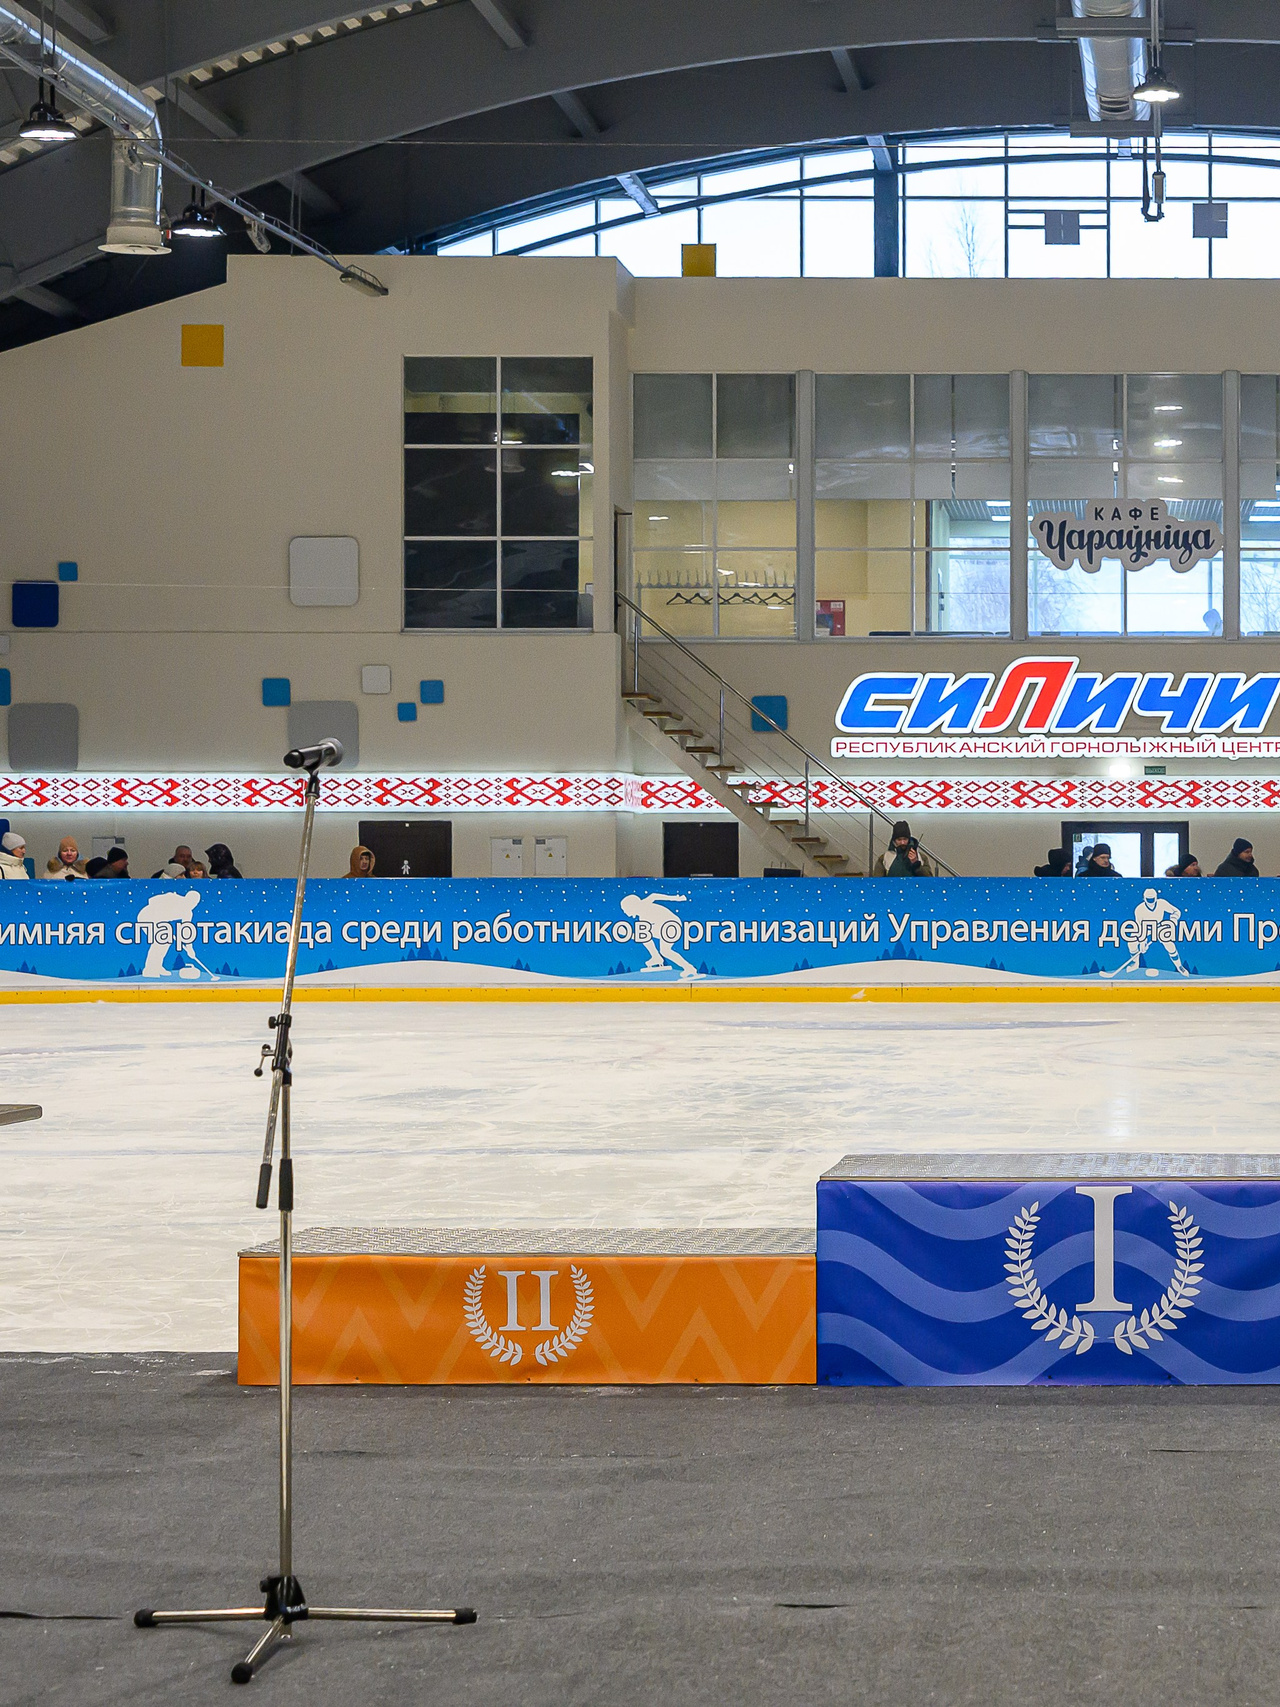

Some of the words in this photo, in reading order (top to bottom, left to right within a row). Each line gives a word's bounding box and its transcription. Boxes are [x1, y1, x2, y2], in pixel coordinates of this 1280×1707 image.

[1094, 507, 1159, 521] КАФЕ
[1039, 519, 1215, 565] Чараўніца
[835, 738, 1045, 754] РЕСПУБЛИКАНСКИЙ
[1050, 738, 1217, 754] ГОРНОЛЫЖНЫЙ
[116, 922, 332, 950] спартакиада
[341, 920, 442, 949] среди
[453, 912, 652, 950] работников
[661, 913, 880, 950] организаций
[889, 913, 1090, 950] Управления
[1099, 920, 1222, 947] делами
[1076, 1186, 1132, 1311] I
[498, 1271, 559, 1331] II
